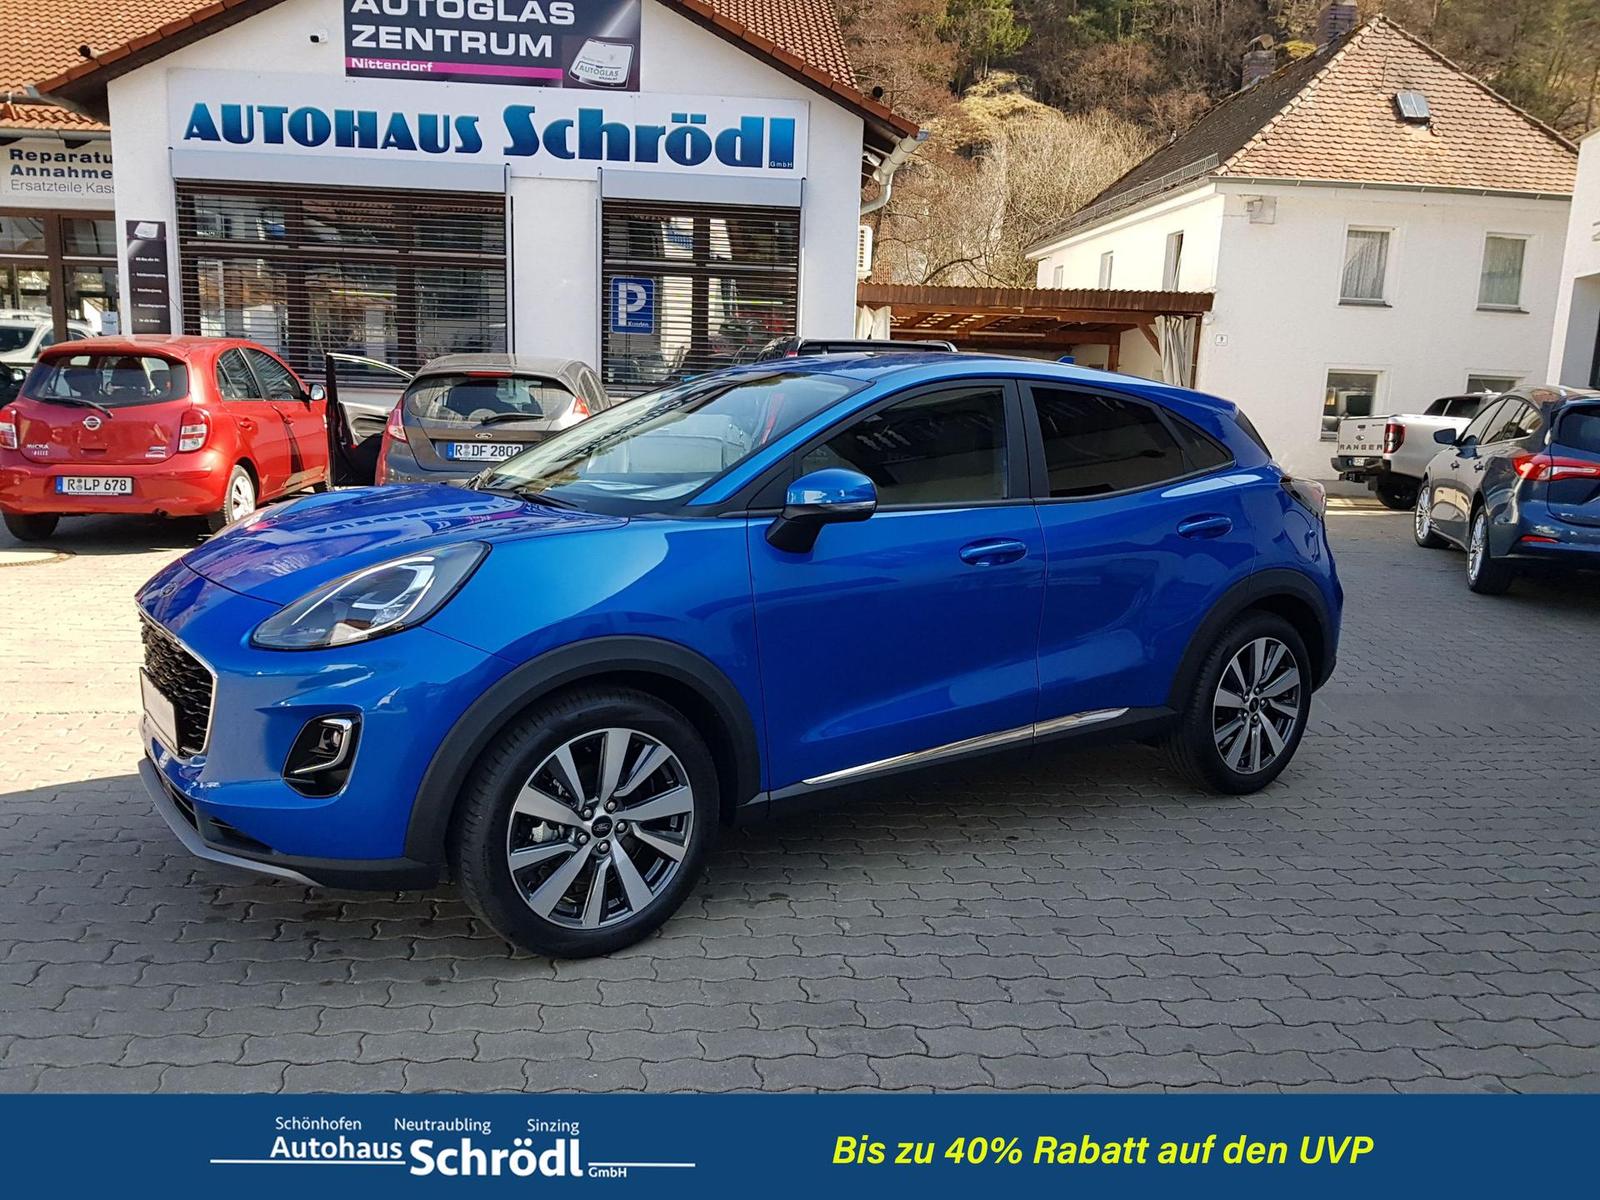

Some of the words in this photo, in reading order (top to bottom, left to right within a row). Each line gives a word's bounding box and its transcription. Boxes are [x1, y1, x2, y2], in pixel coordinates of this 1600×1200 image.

[350, 0, 576, 25] AUTOGLAS
[351, 24, 552, 58] ZENTRUM
[351, 58, 433, 71] Nittendorf
[579, 64, 619, 77] AUTOGLAS
[183, 102, 483, 154] AUTOHAUS
[503, 104, 795, 169] Schrödl
[769, 160, 793, 168] GmbH
[10, 164, 112, 179] Annahme
[11, 179, 82, 193] Ersatzteile
[618, 282, 647, 326] P
[455, 445, 463, 456] R
[472, 445, 487, 456] DF
[68, 479, 75, 490] R
[84, 479, 99, 490] LP
[104, 480, 127, 491] 678
